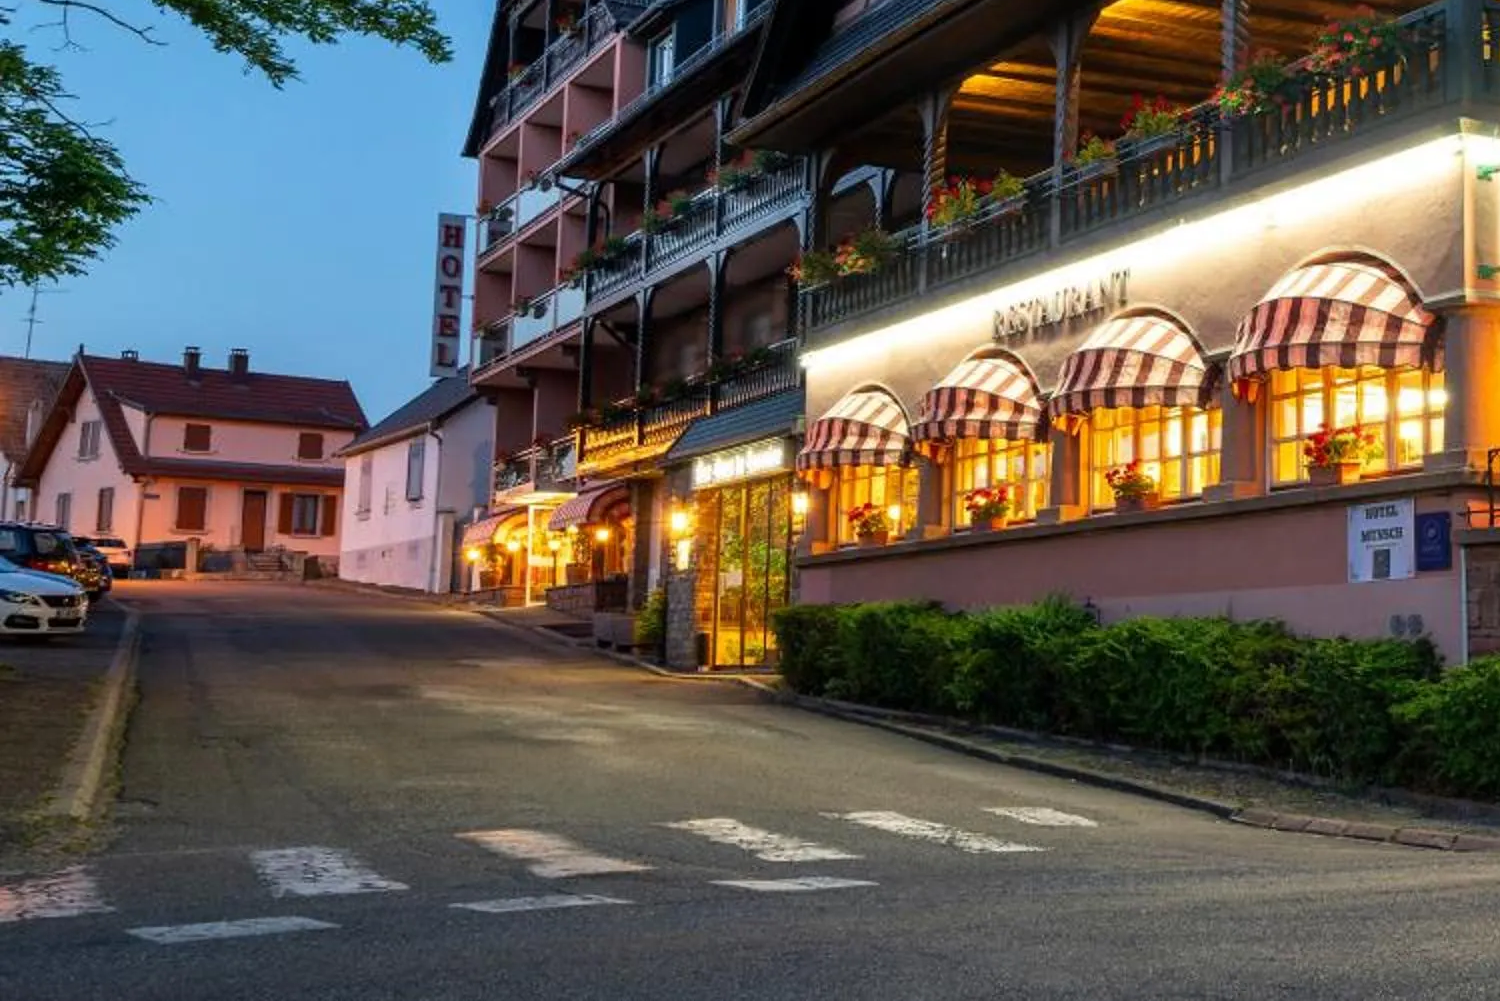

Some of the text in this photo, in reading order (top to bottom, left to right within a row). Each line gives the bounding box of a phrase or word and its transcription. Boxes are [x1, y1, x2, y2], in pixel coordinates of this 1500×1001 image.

[436, 224, 463, 367] HOTEL
[992, 268, 1130, 340] RESTAURANT
[1365, 504, 1399, 520] HOTEL
